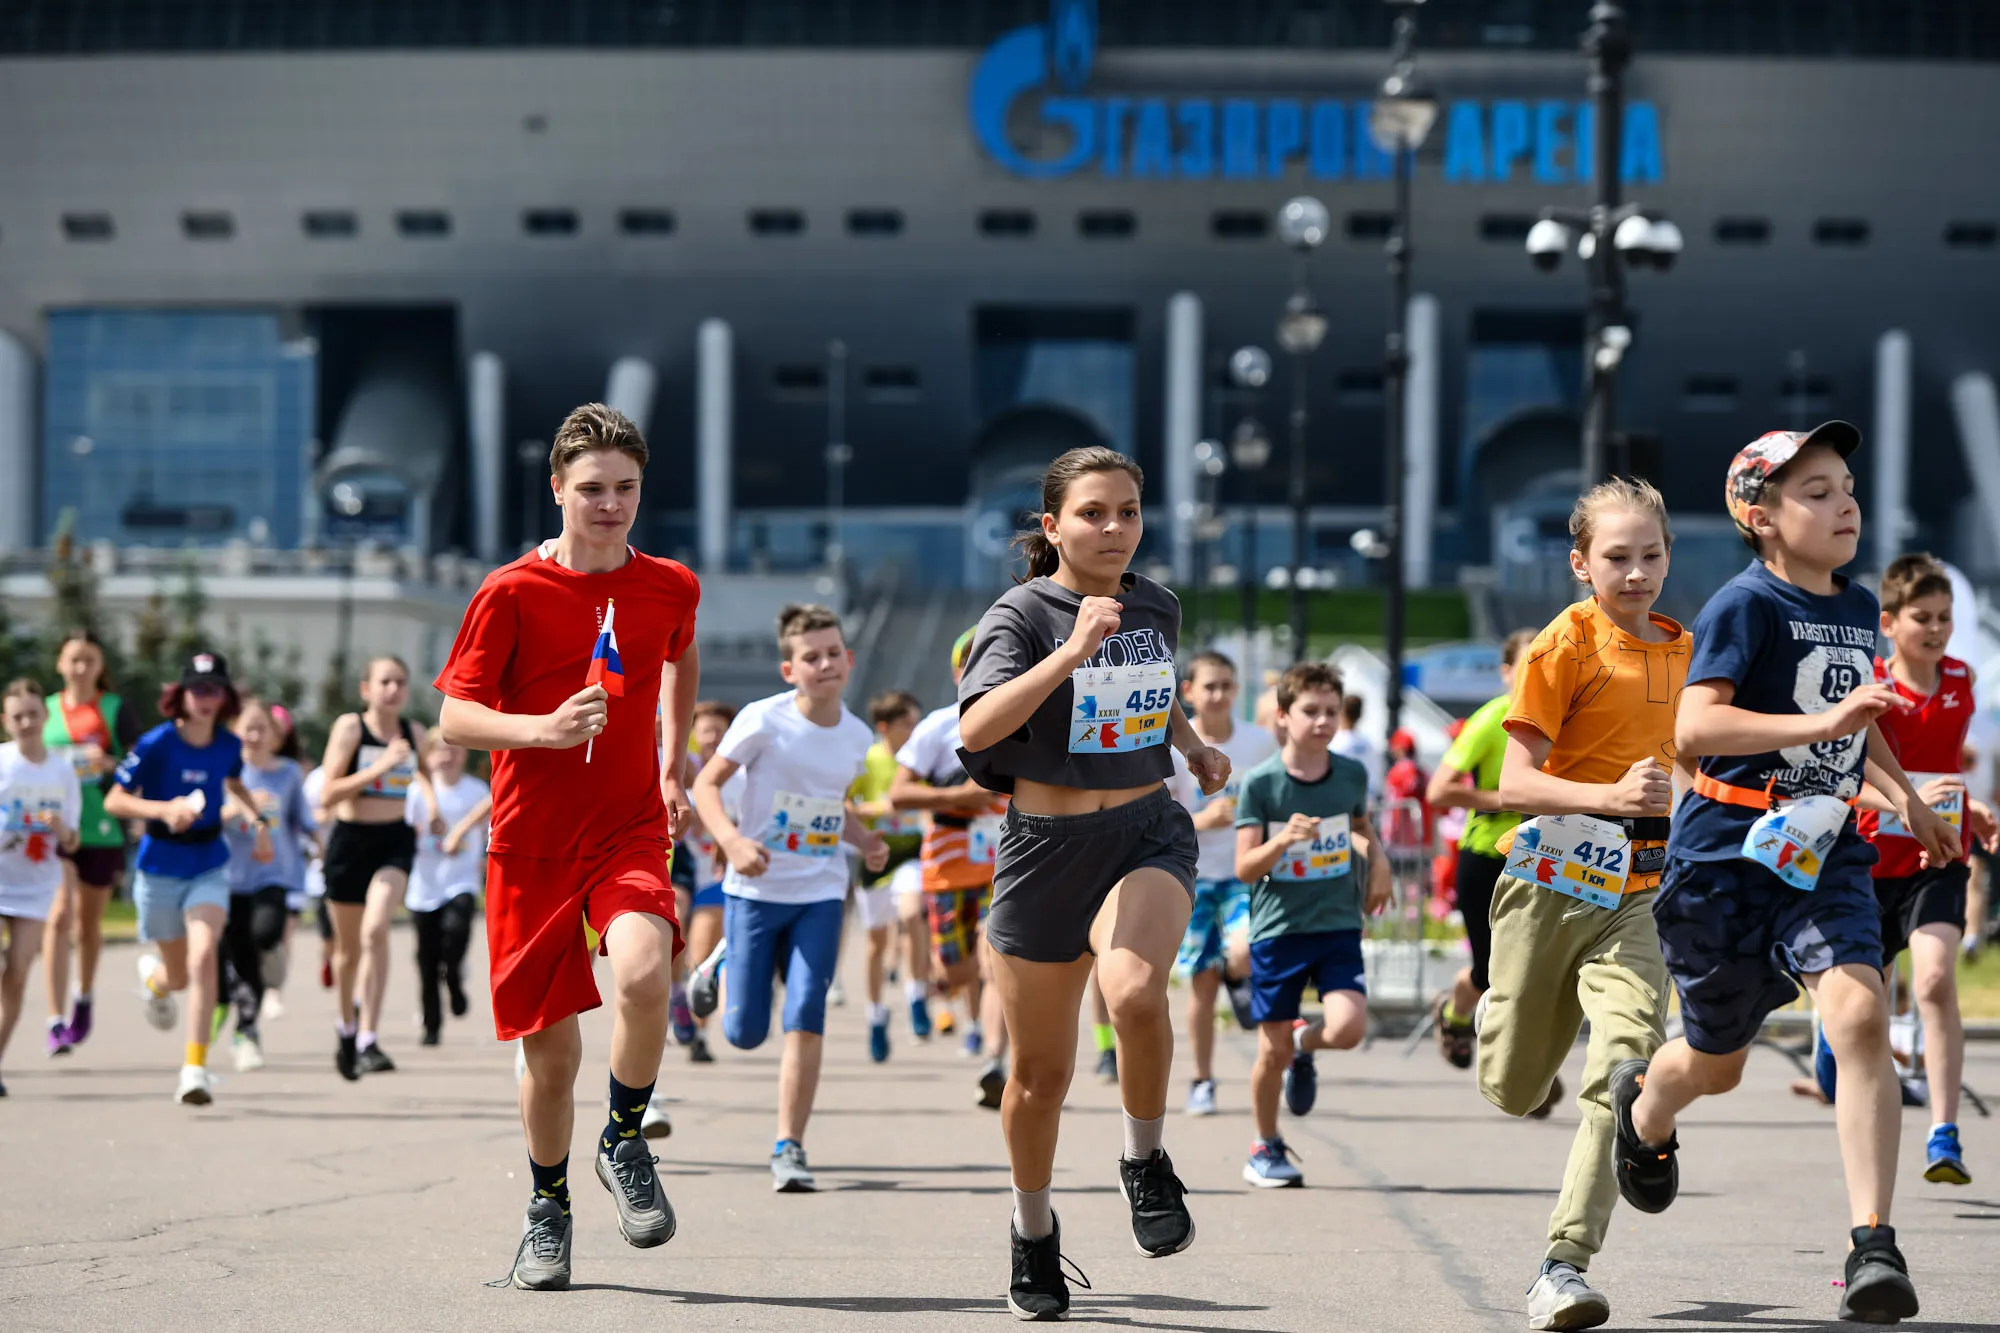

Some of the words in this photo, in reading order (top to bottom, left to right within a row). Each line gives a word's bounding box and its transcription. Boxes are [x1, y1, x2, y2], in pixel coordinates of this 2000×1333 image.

[1788, 620, 1839, 644] VARSITY
[1826, 647, 1856, 664] SINCE
[1827, 668, 1853, 699] 19
[1126, 687, 1171, 713] 455
[1098, 709, 1120, 718] XXXIV
[1139, 719, 1143, 730] 1
[811, 815, 842, 831] 457
[1311, 832, 1347, 852] 465
[1539, 844, 1564, 857] XXXIV
[1574, 840, 1623, 873] 412
[1581, 870, 1587, 881] 1
